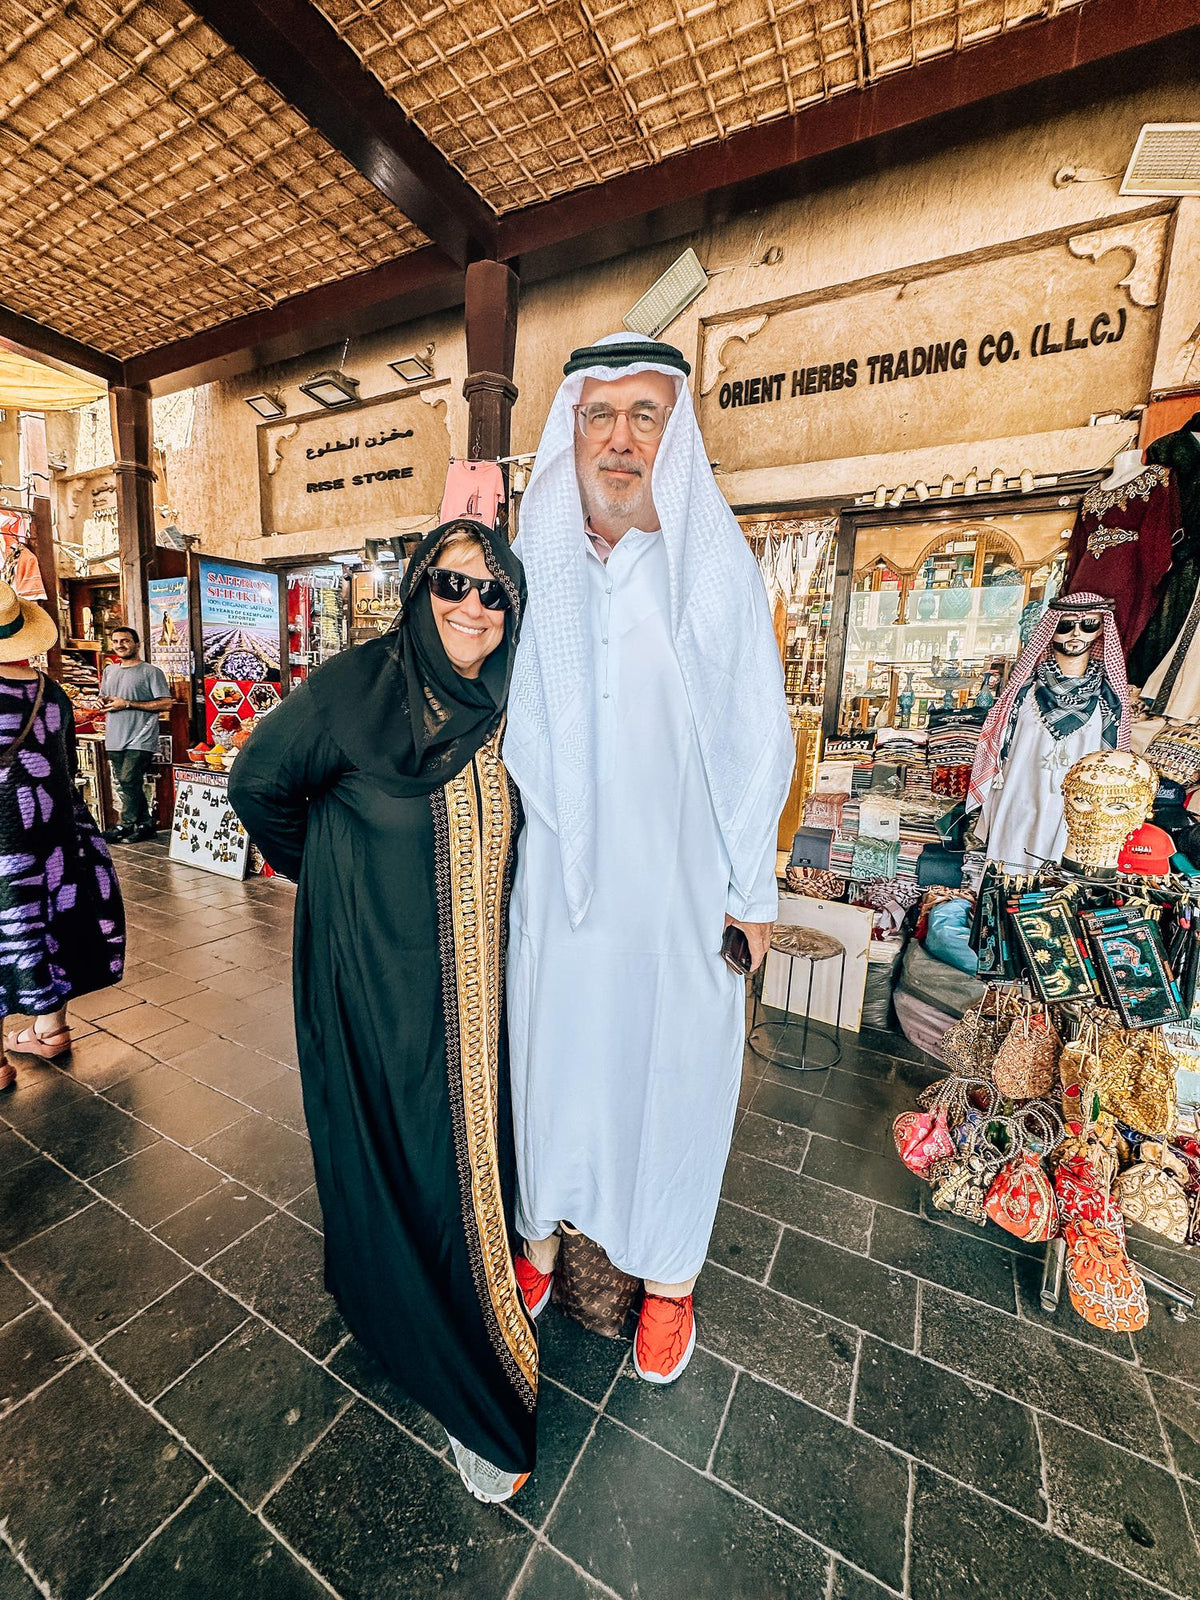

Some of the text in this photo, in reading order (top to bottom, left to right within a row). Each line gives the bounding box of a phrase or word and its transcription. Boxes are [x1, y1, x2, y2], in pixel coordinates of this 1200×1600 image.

[719, 308, 1127, 409] ORIENT HERBS TRADING CO. (L.L.C.)
[306, 428, 414, 460] مخزن الطلوع
[306, 467, 414, 494] RISE STORE
[207, 571, 273, 590] SAFFRON
[1059, 934, 1080, 967] DUBAI
